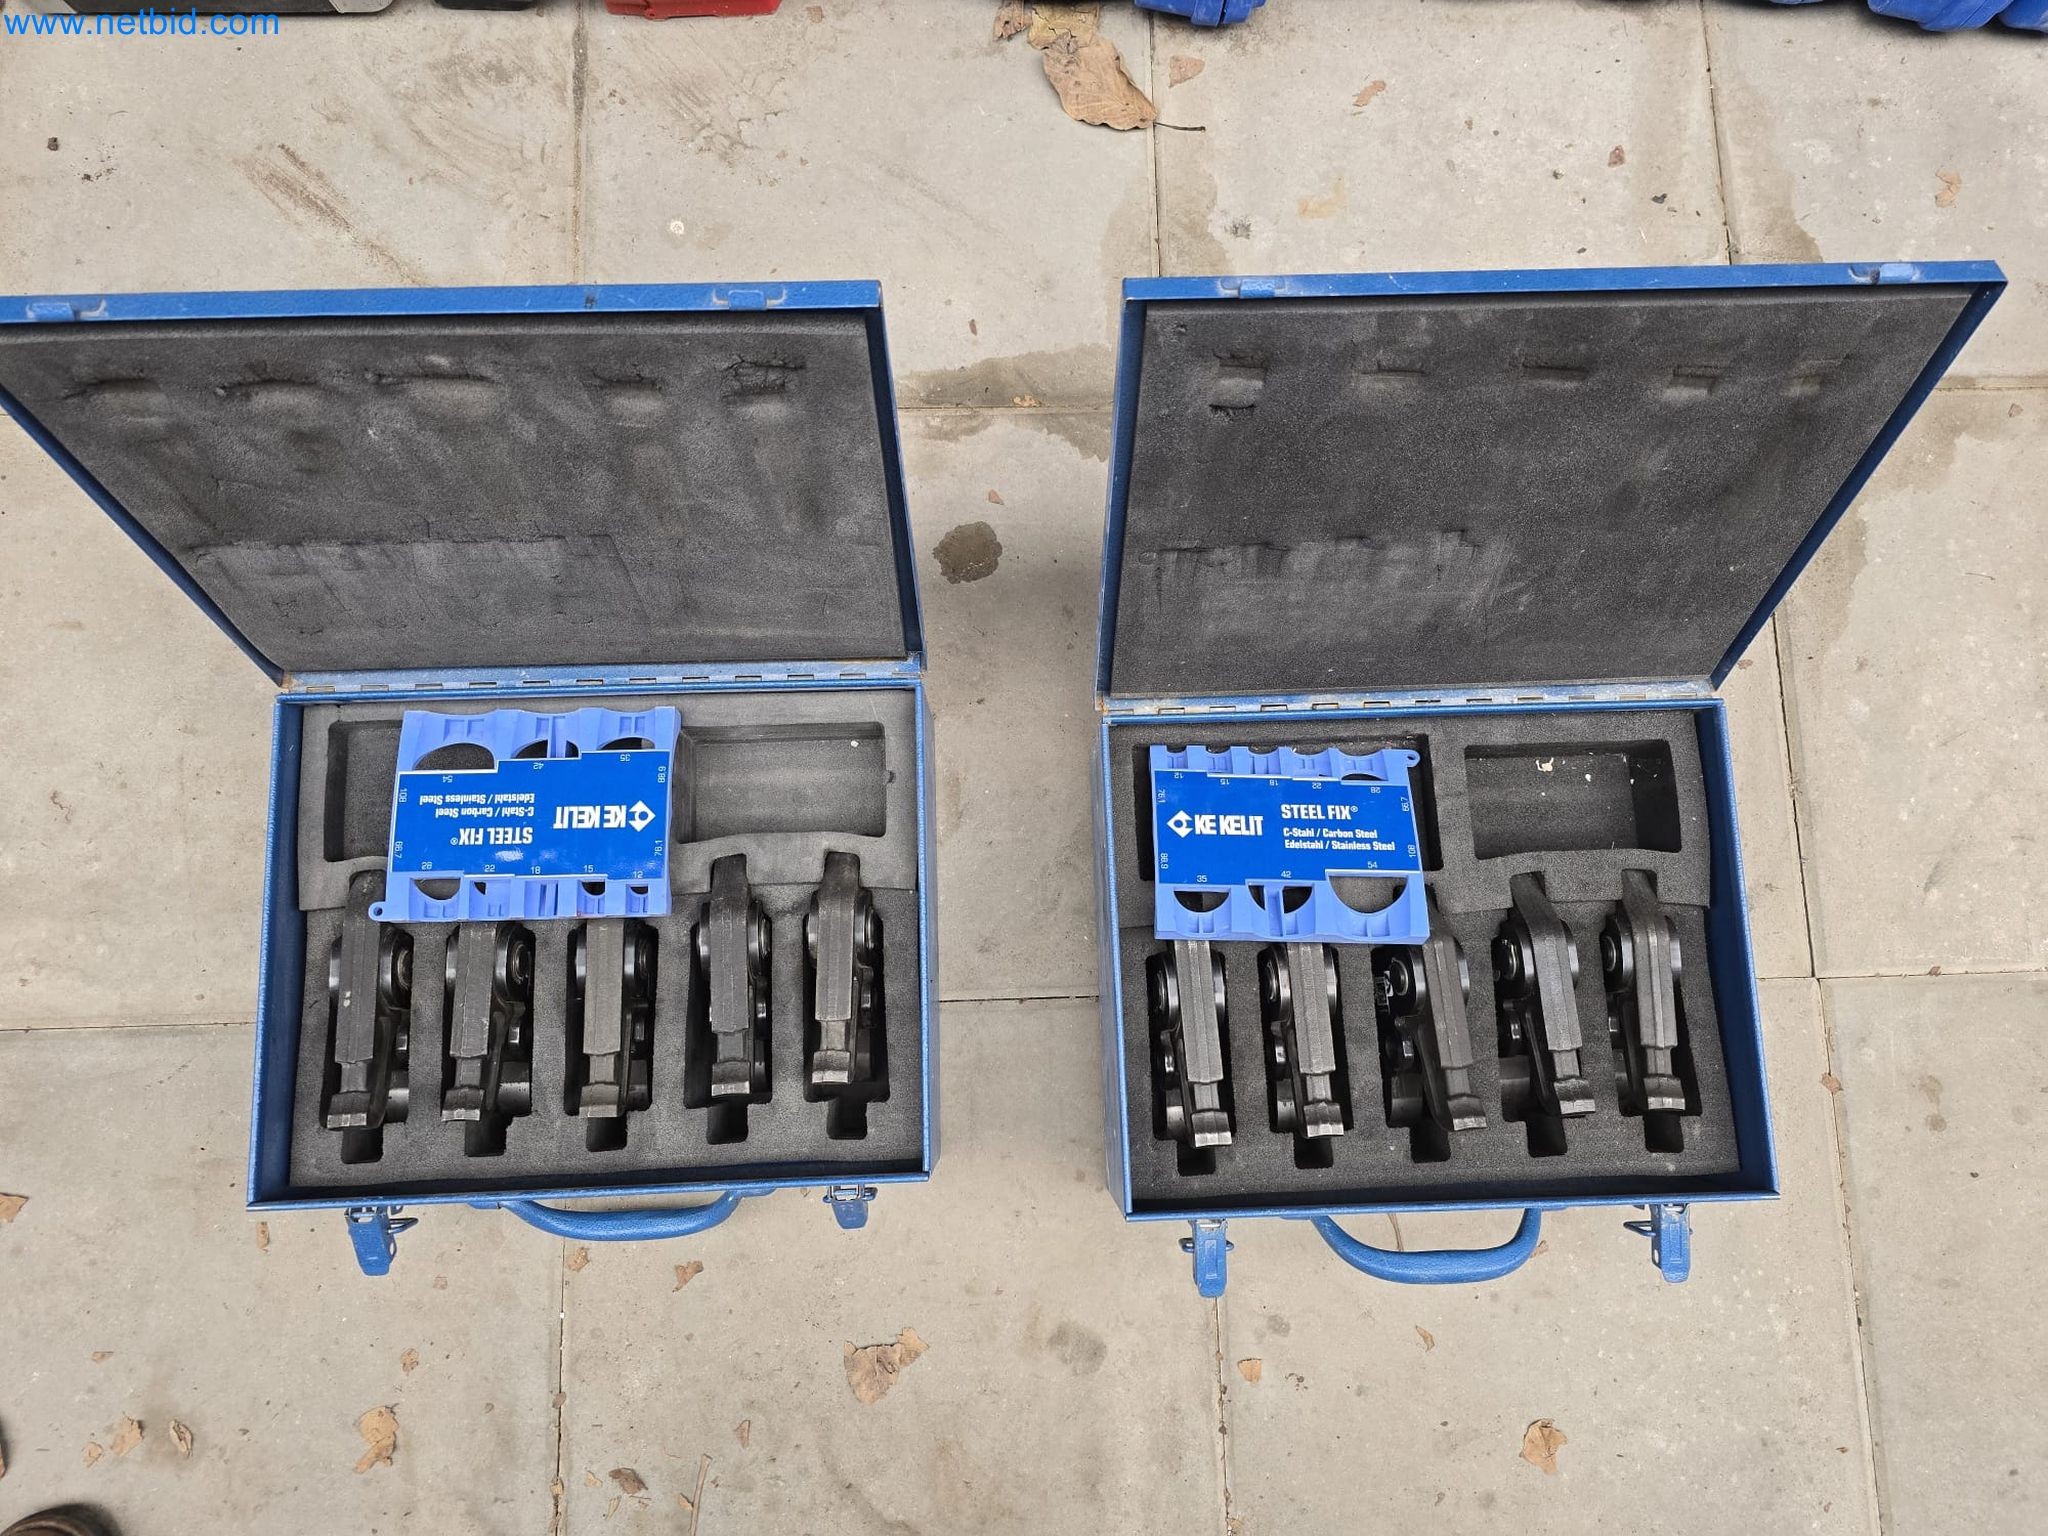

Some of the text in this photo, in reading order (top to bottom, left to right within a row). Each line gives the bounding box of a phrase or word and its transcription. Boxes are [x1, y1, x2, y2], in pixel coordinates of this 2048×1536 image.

[620, 754, 631, 762] 35
[533, 762, 544, 770] 42
[419, 793, 535, 805] Edelstahl / Stainless Steel
[435, 807, 534, 818] C-Stahl / Carbon Steel
[1280, 804, 1325, 819] STEEL
[553, 806, 627, 829] KE KELIT
[1194, 815, 1263, 836] KE KELIT
[487, 827, 533, 844] STEEL
[1283, 828, 1377, 839] C-Stahl / Carbon Steel
[1285, 840, 1395, 851] Edelstahl / Stainless Steel
